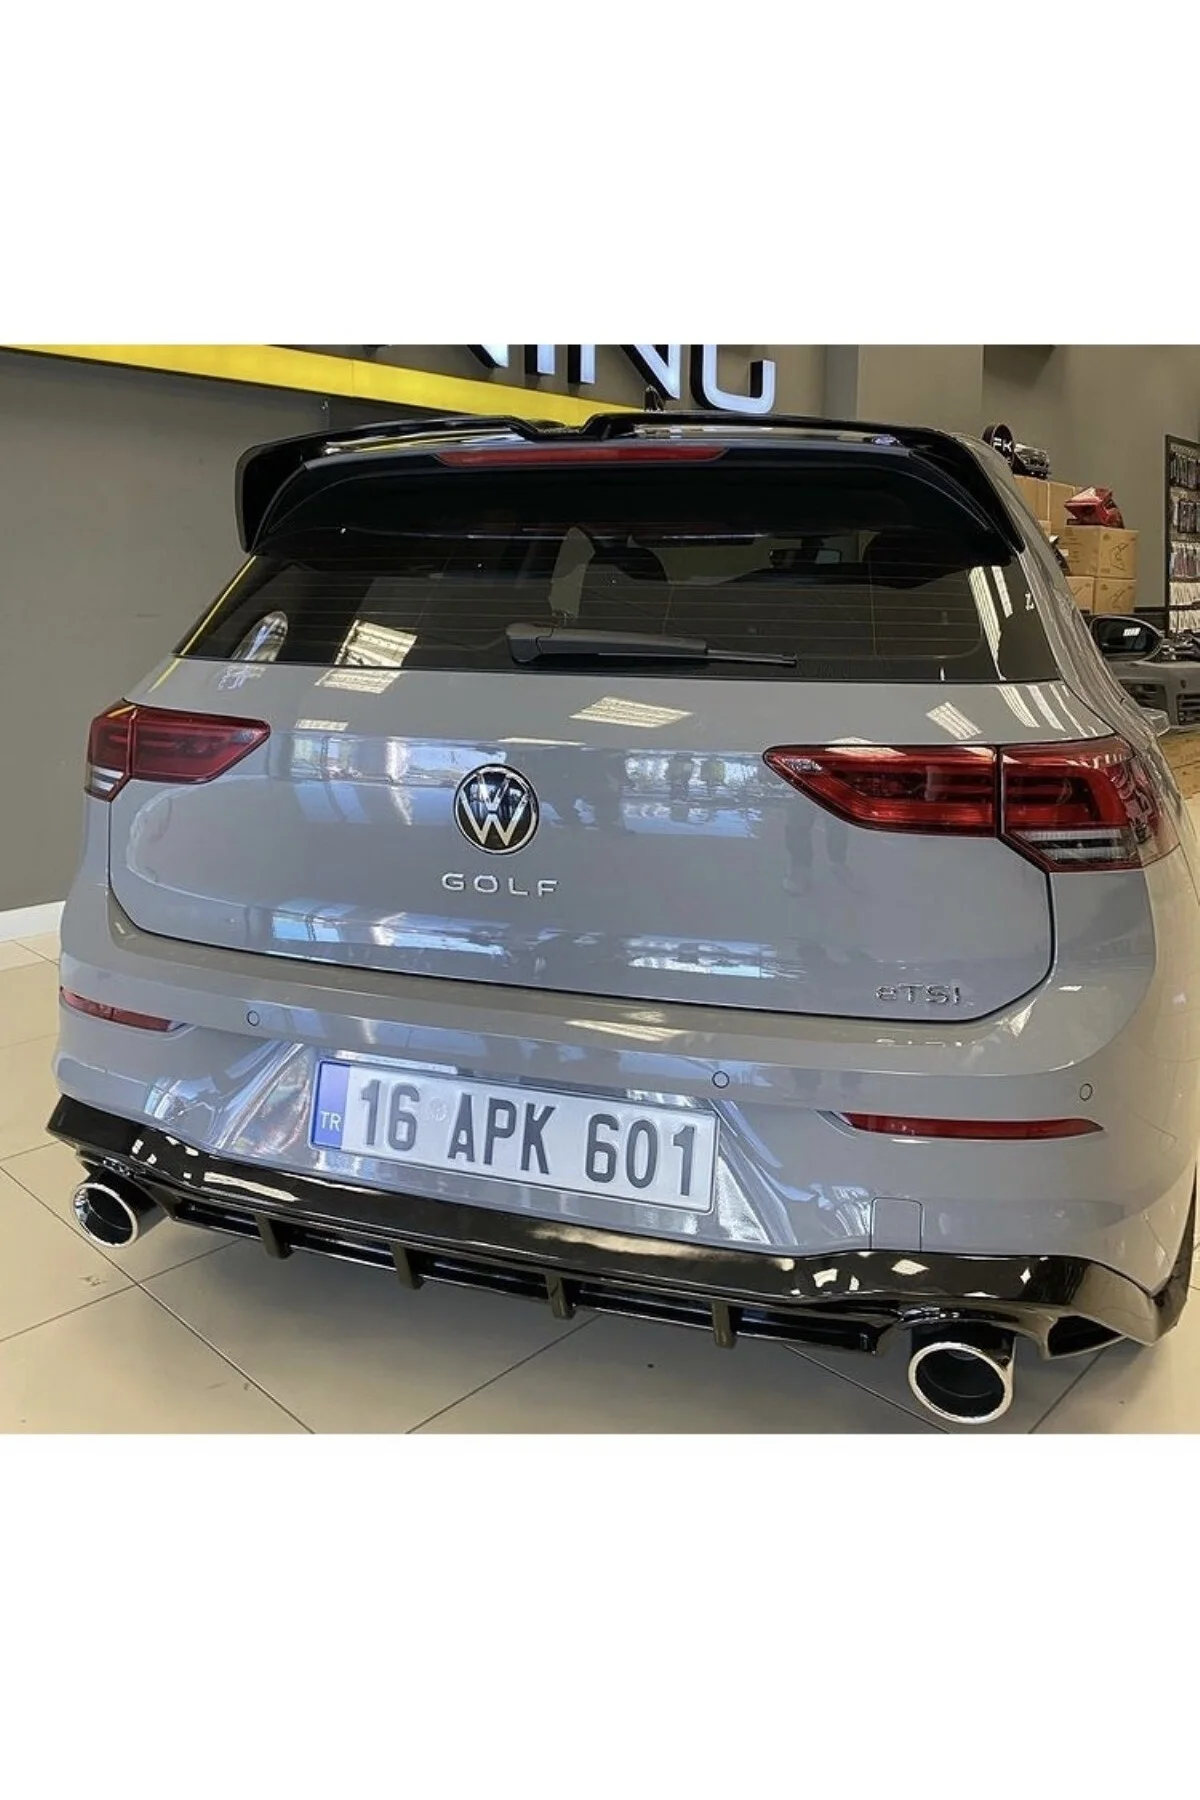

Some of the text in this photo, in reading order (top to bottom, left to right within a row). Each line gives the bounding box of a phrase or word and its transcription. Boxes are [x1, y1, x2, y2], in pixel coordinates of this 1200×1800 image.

[441, 873, 557, 897] GOLF
[875, 983, 960, 1005] eTSI
[320, 1110, 341, 1132] TR
[361, 1079, 695, 1196] 16 APK 601
